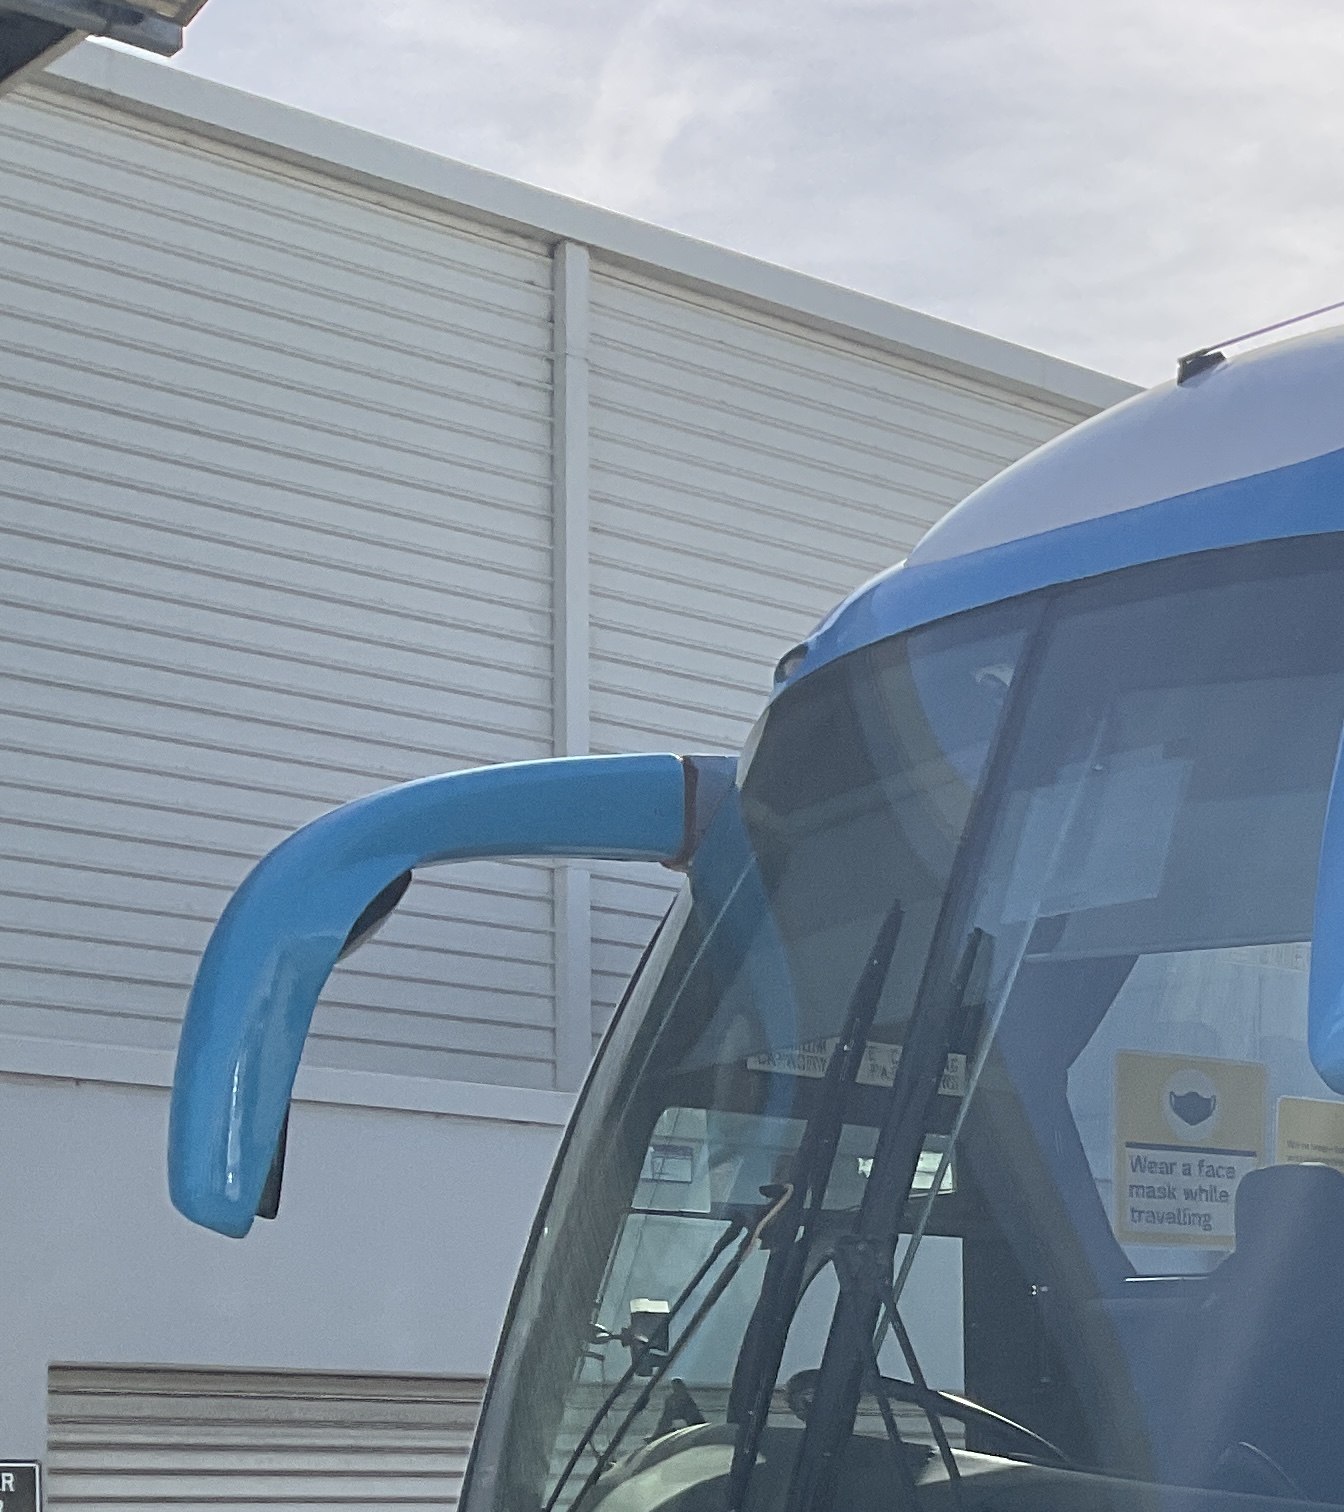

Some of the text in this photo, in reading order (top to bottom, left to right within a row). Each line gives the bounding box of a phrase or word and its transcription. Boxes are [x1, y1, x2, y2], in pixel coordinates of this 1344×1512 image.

[1130, 1155, 1236, 1179] Wear a face
[1128, 1182, 1230, 1203] mask while
[1130, 1205, 1213, 1231] travelling
